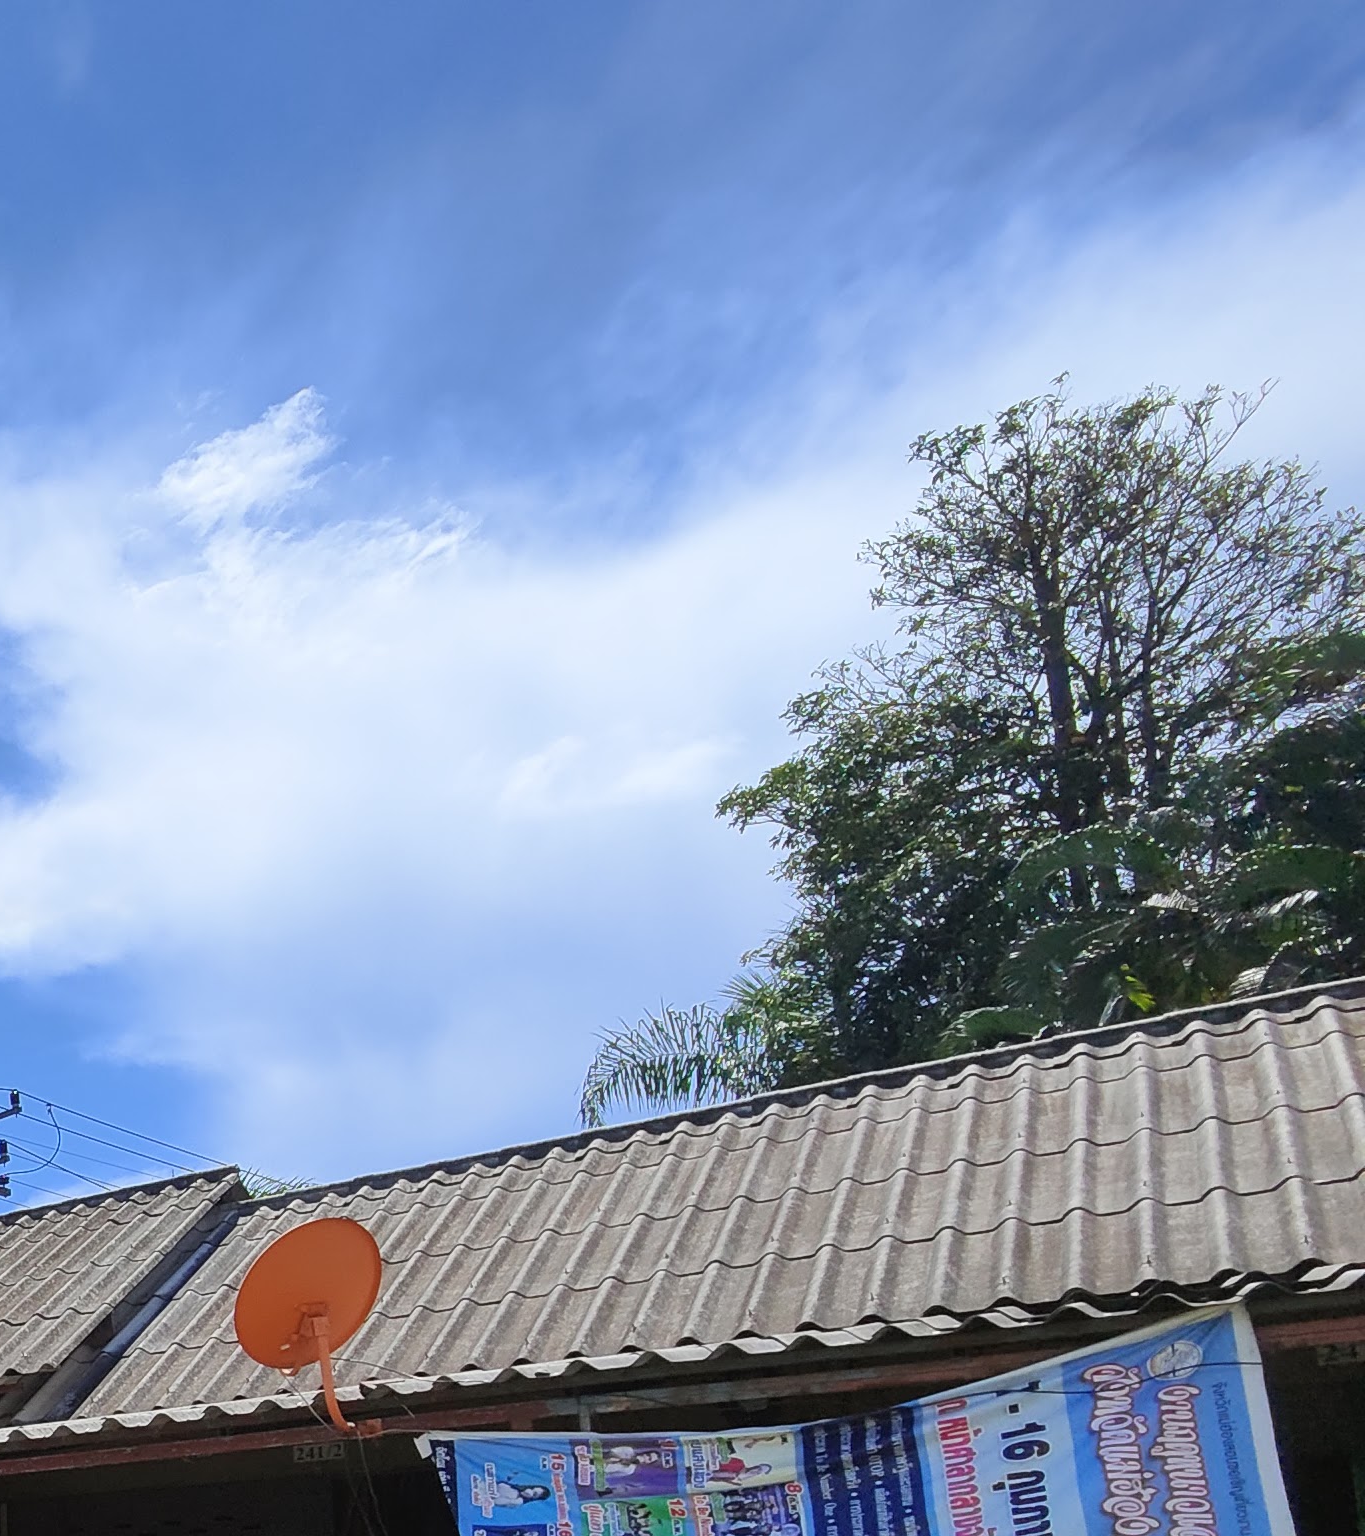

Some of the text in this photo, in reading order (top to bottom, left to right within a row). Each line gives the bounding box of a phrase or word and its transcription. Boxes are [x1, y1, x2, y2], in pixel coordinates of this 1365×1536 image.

[1000, 1423, 1051, 1460] 16
[296, 1445, 342, 1461] 241/2
[551, 1454, 565, 1470] 15
[868, 1456, 885, 1477] OTOP
[785, 1484, 801, 1493] 8
[819, 1474, 834, 1500] Number
[695, 1496, 707, 1504] To
[669, 1500, 686, 1517] 12
